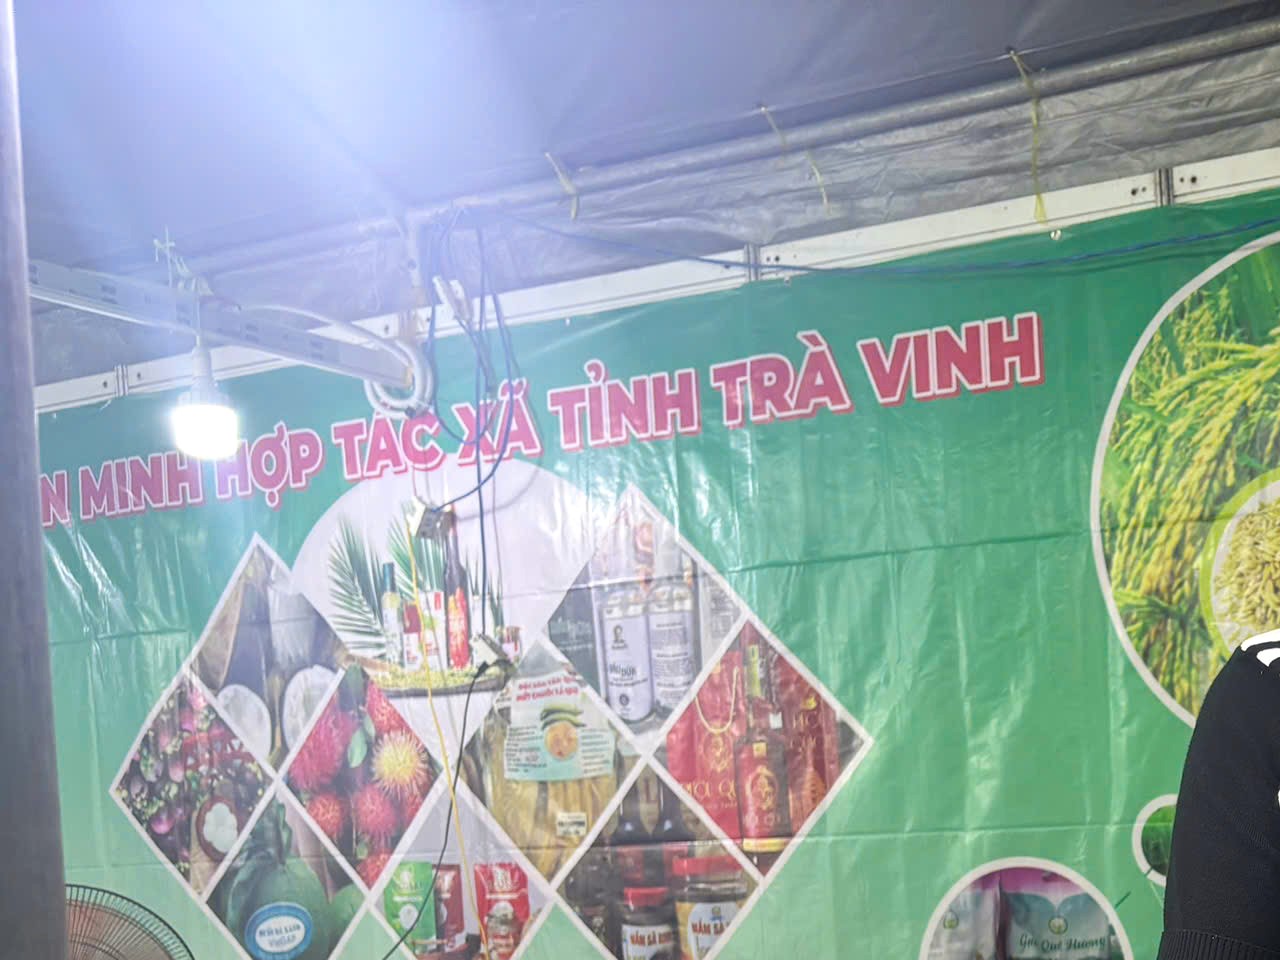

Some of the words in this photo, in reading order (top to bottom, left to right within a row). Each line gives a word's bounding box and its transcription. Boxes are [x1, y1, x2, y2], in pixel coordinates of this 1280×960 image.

[78, 451, 203, 520] MINH
[216, 420, 324, 511] HỢP
[455, 377, 541, 465] XÃ
[548, 359, 701, 452] TỈNH
[710, 329, 854, 429] TRÀ
[857, 311, 1045, 407] VINH
